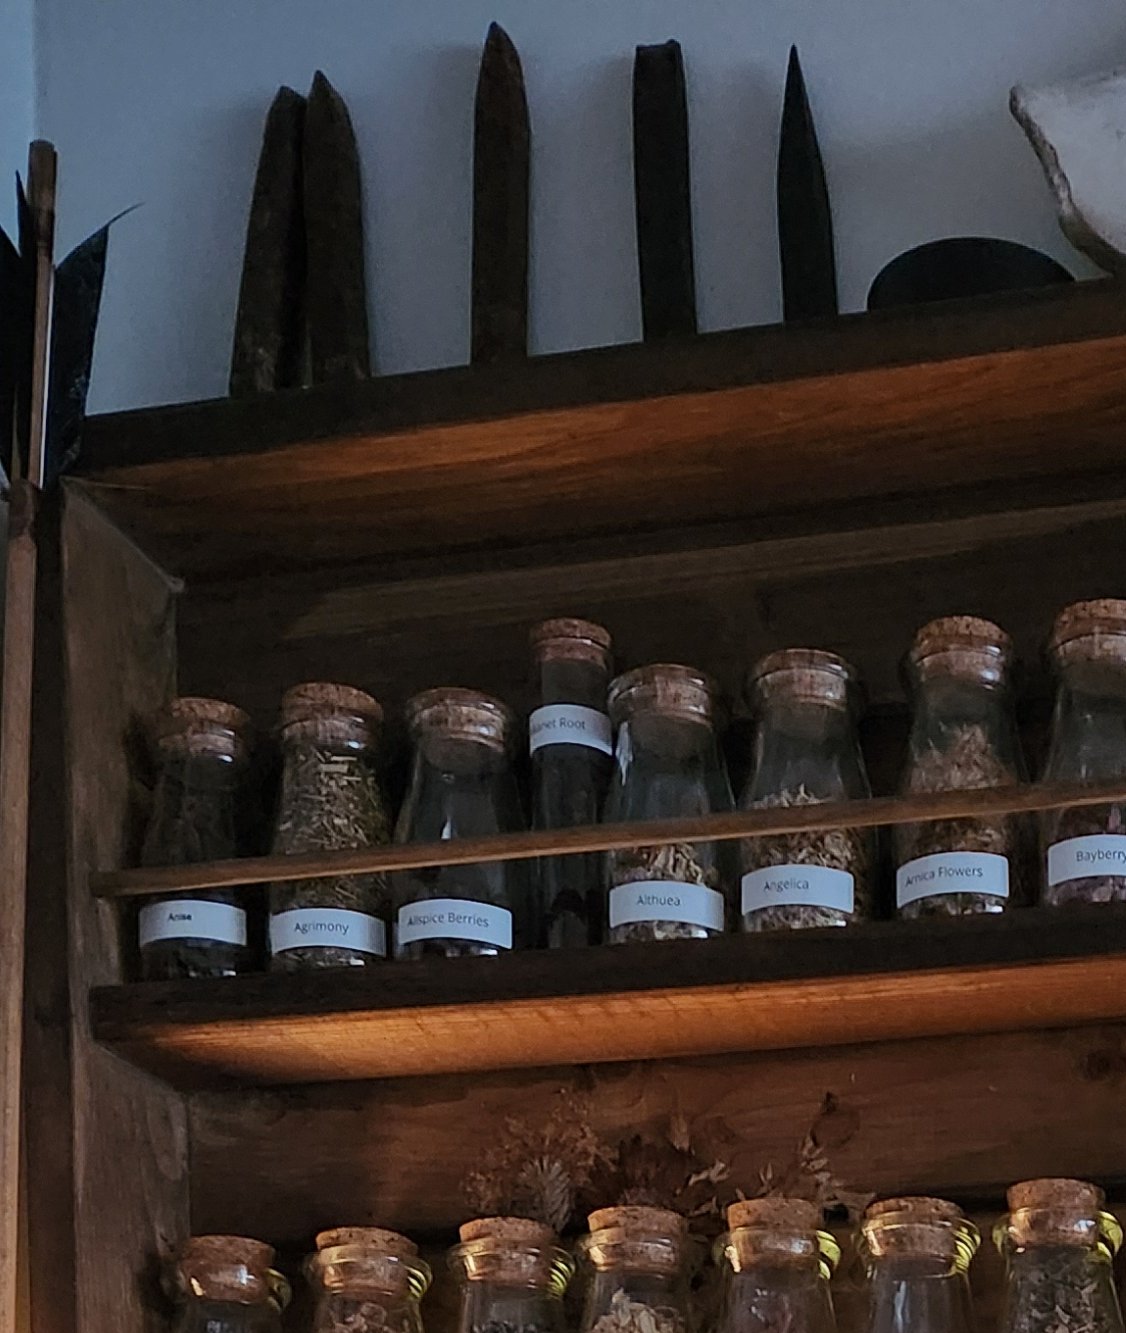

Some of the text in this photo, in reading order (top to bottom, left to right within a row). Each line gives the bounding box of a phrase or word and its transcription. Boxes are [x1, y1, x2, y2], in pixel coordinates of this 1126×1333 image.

[559, 717, 586, 730] Root
[905, 866, 984, 887] Arnica Flowers
[764, 880, 809, 893] Angelica
[637, 895, 681, 907] Althuea
[168, 912, 192, 922] Anise
[407, 912, 489, 927] Allspice Berries
[294, 922, 349, 935] Agrimony
